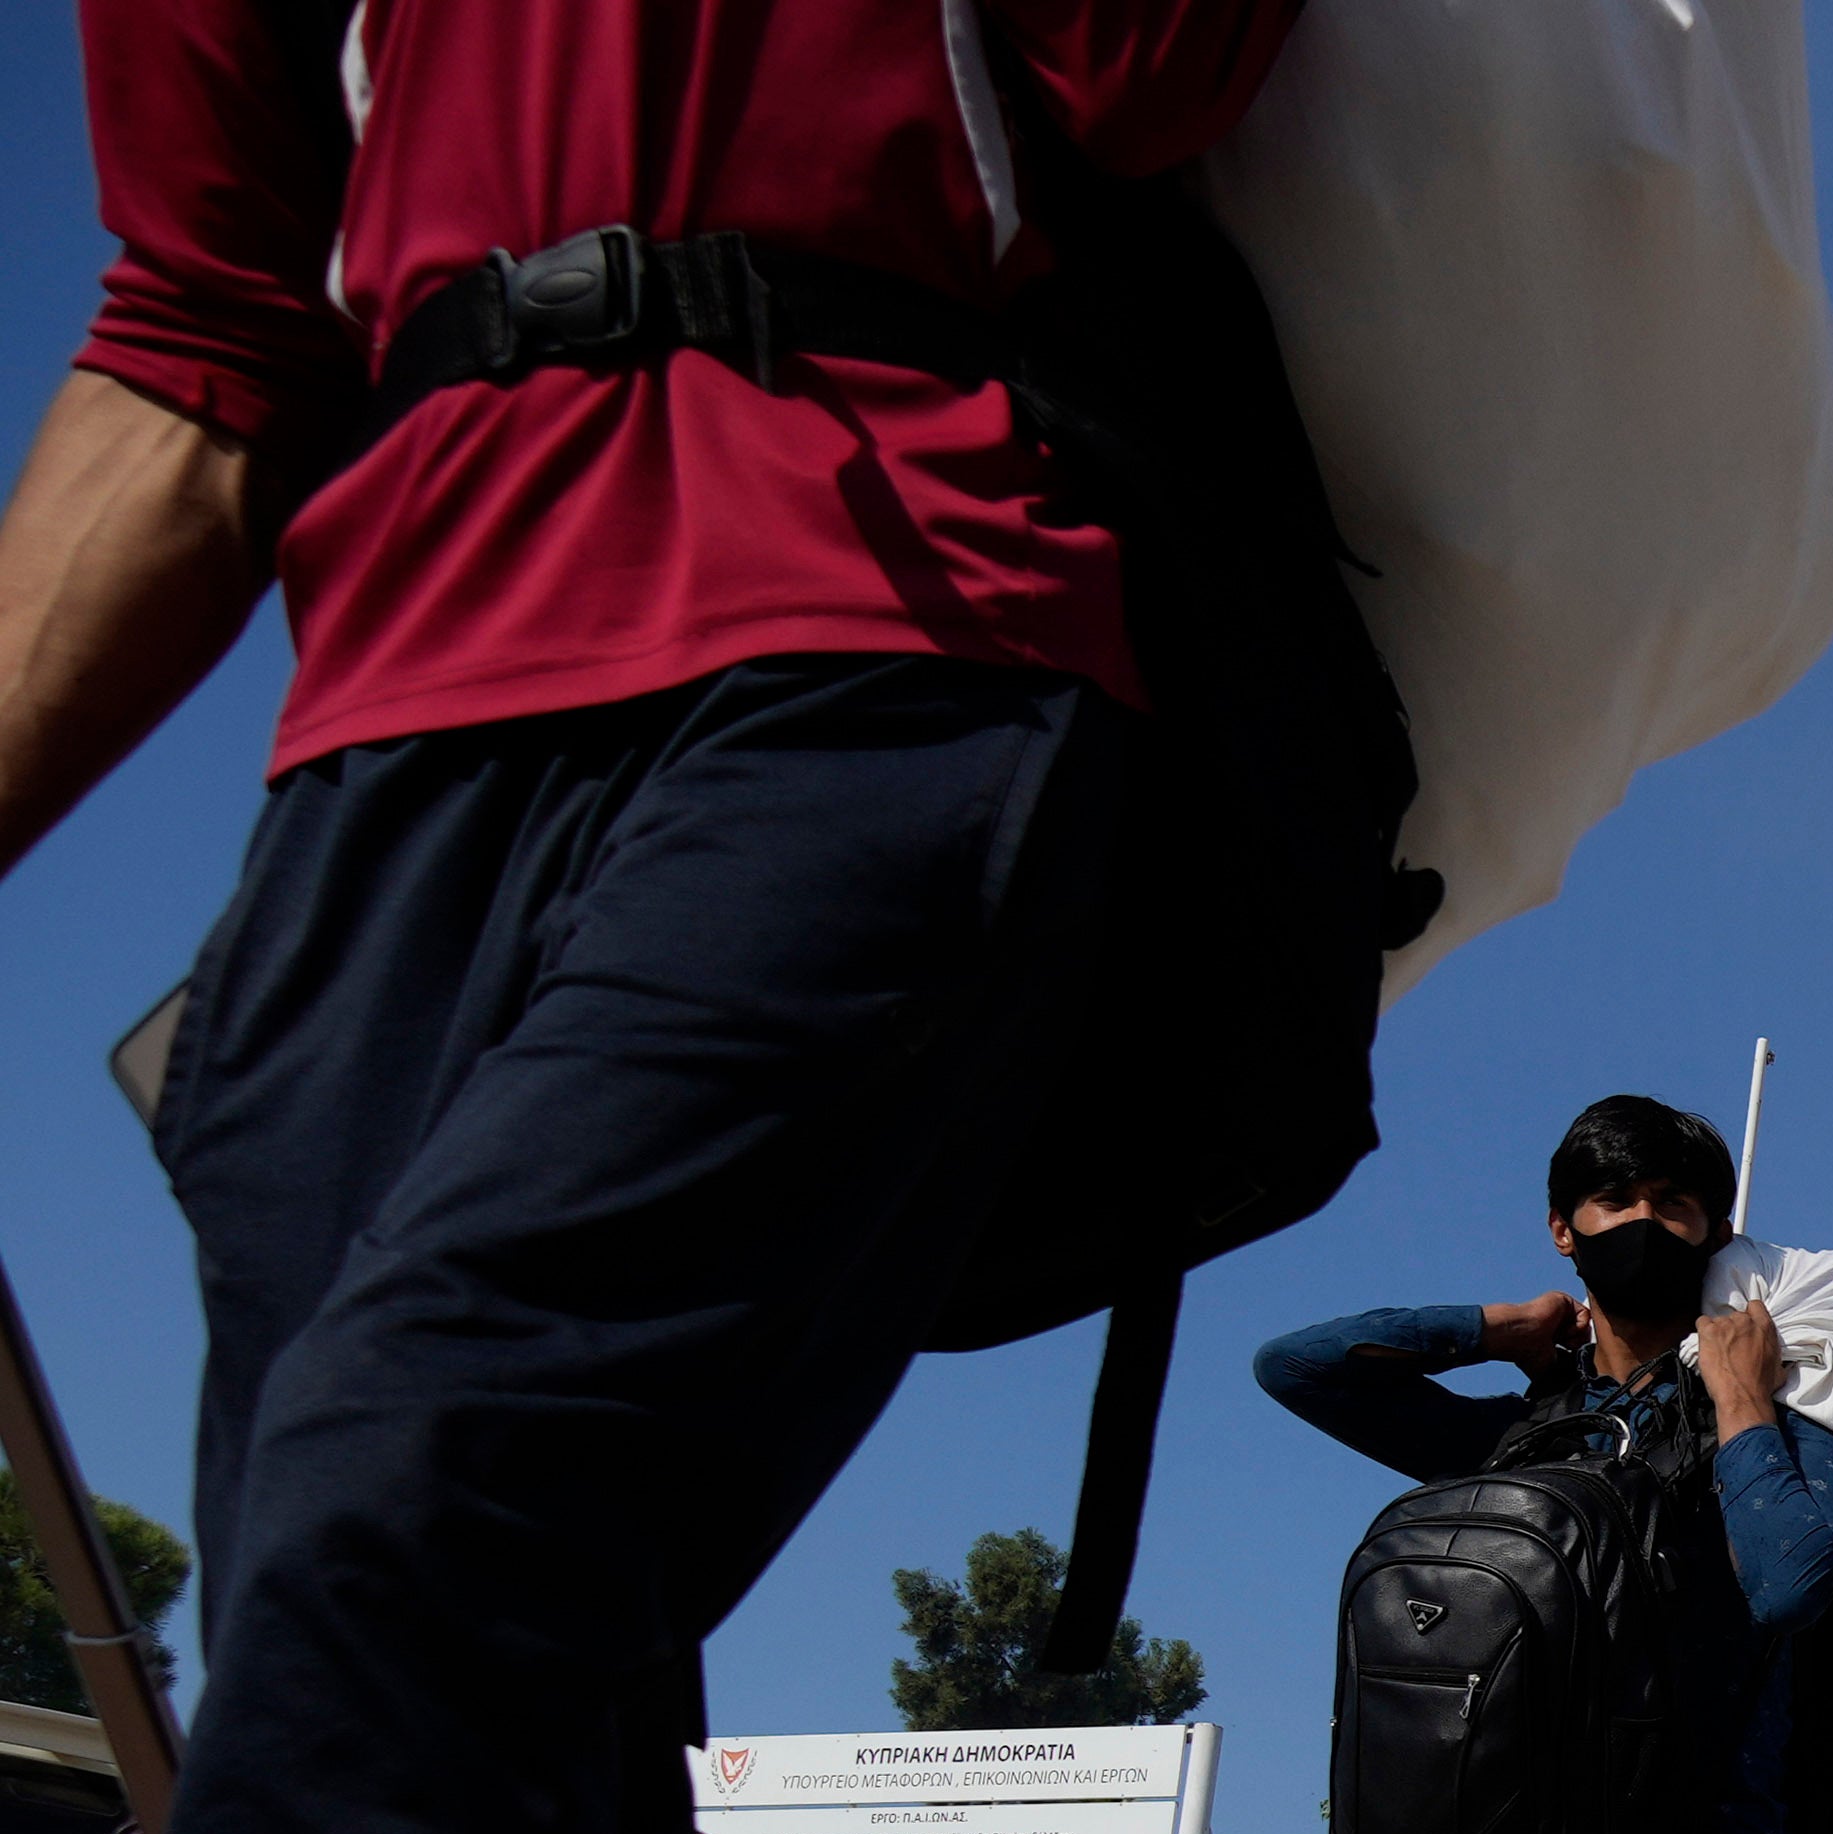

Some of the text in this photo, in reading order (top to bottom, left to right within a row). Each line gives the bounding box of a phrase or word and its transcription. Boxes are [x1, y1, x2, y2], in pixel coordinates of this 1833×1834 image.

[855, 1743, 1076, 1765] ΚΥΠΡΙΑΚΗ ΔΗΜΟΚΡΑΤΙΑ
[782, 1768, 1149, 1789] ΥΠΟΥΡΓΕΙΟ ΜΕΤΑΦΟΡΩΝ ΕΠΙΚΟΙΝΩΝΙΩΝ ΚΑΙ ΕΡΓΩΝ
[871, 1813, 900, 1824] ΕΡΓΟ:
